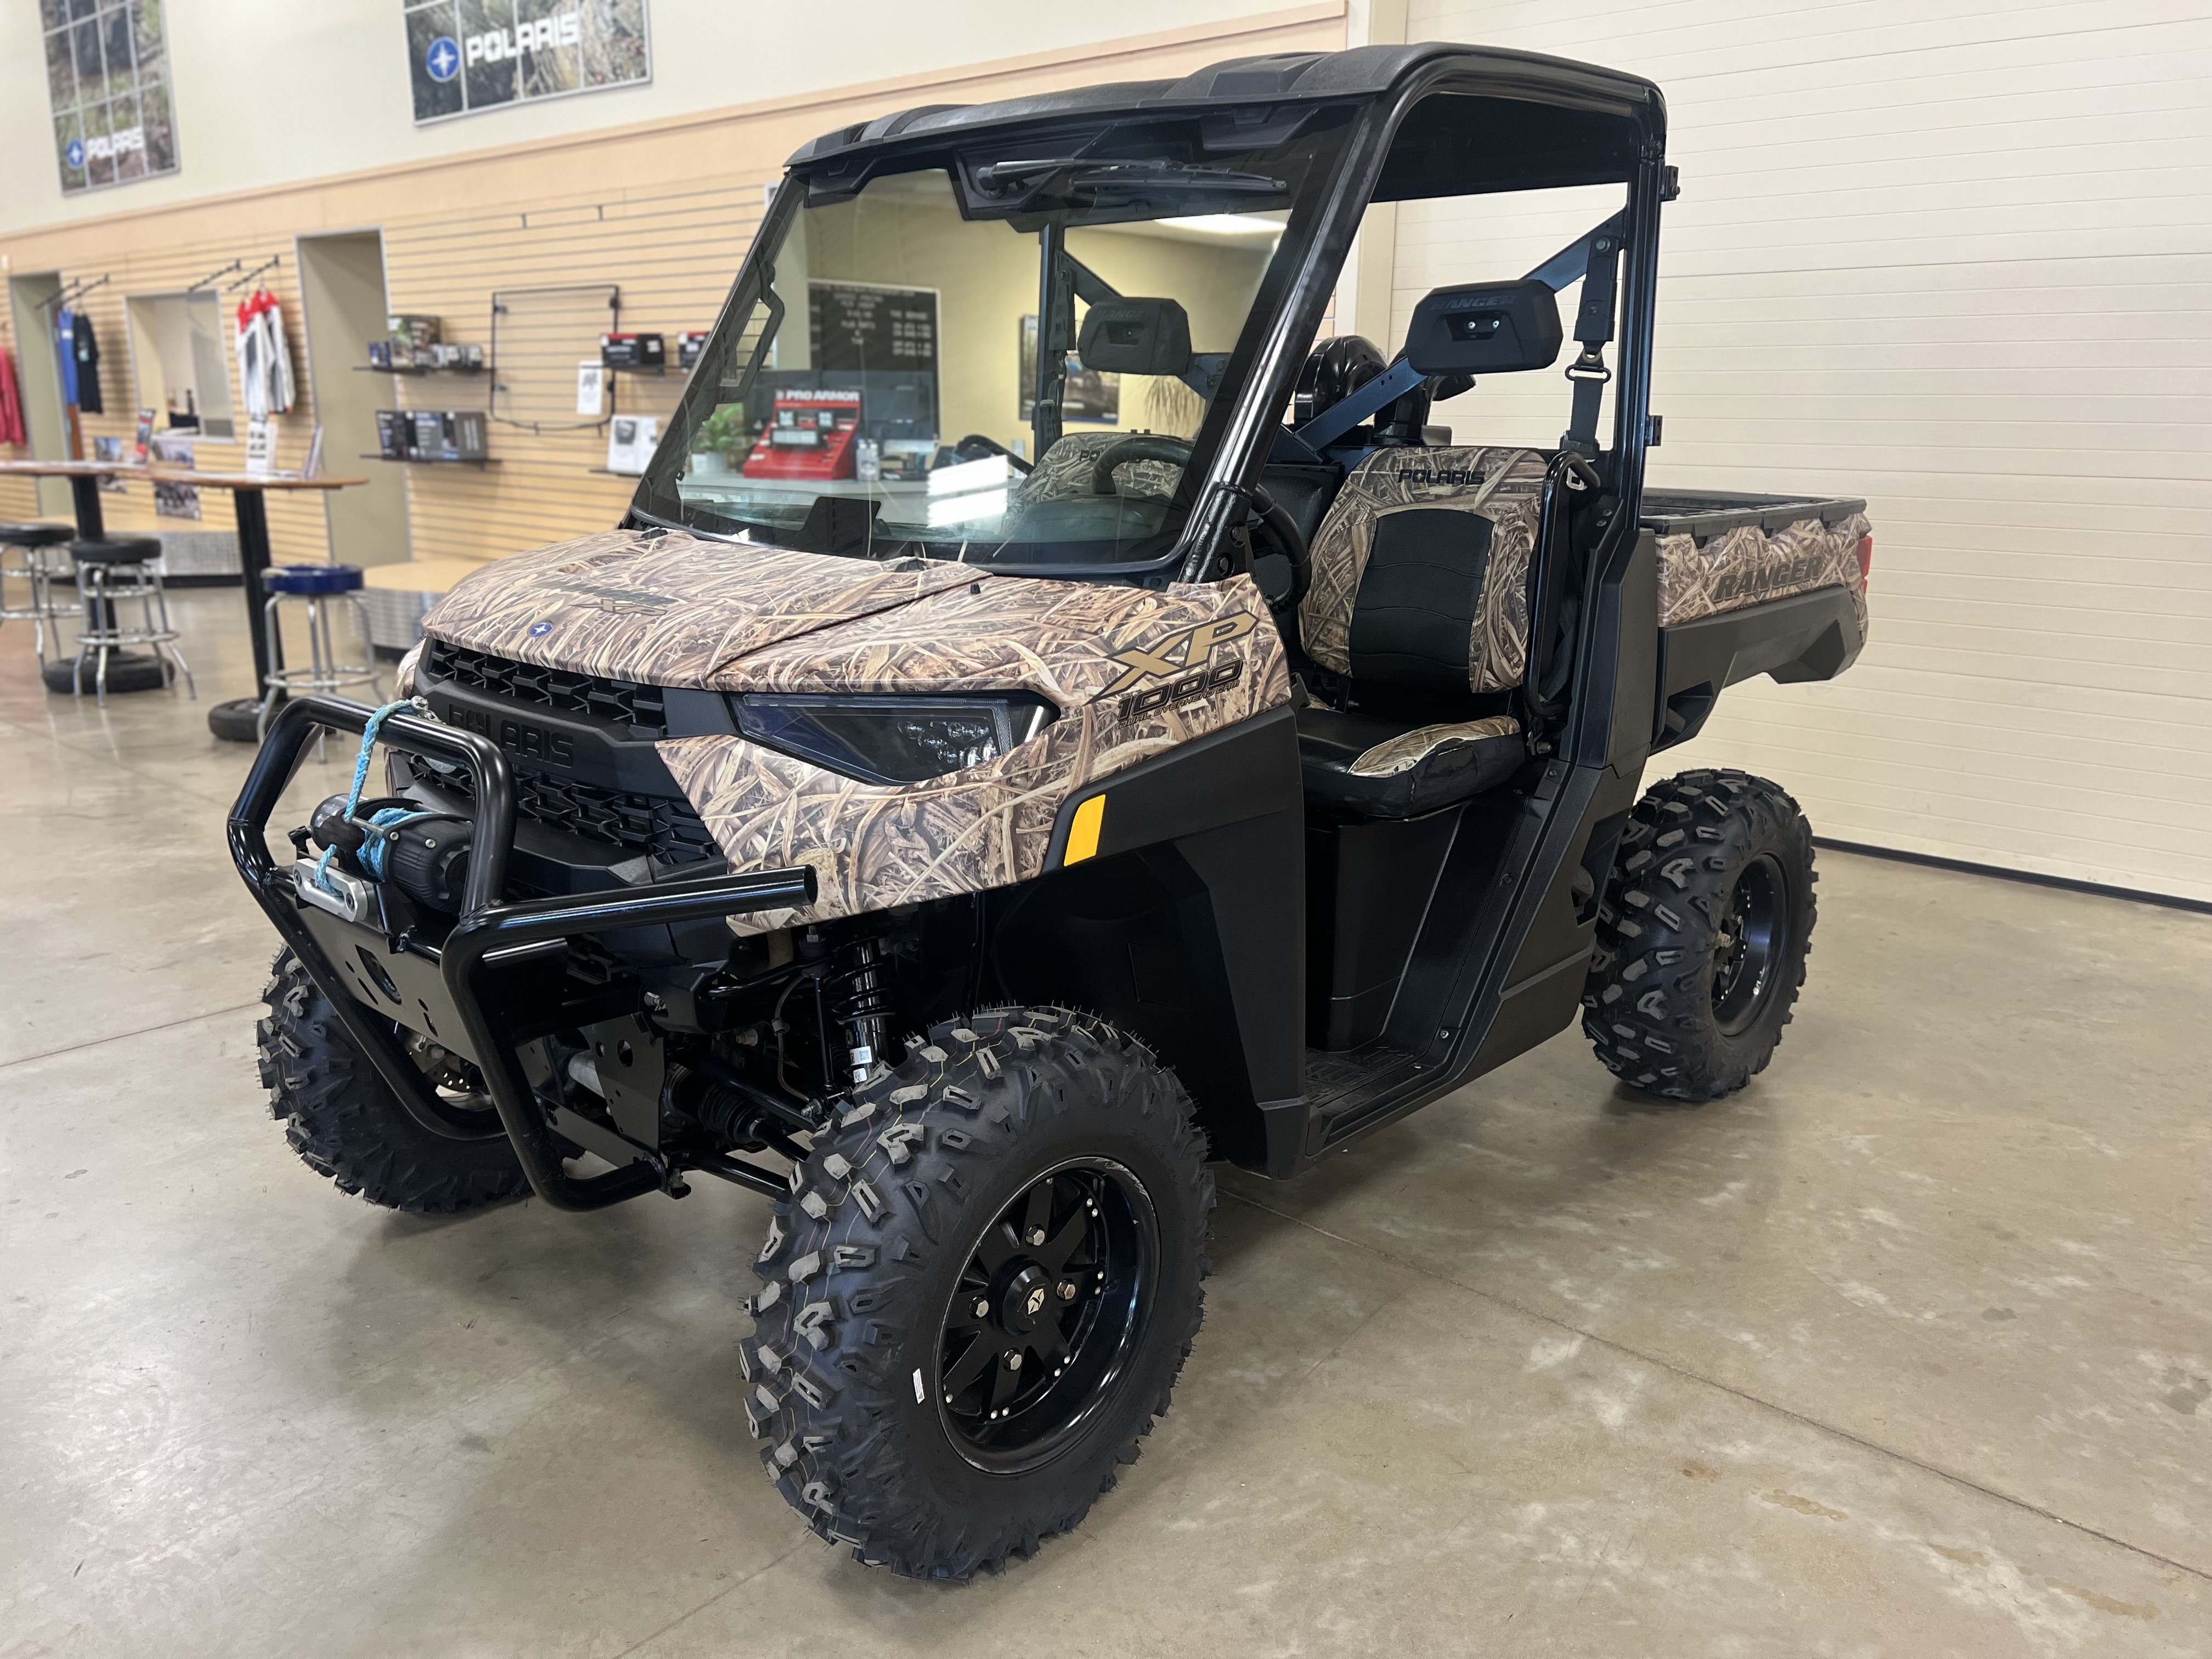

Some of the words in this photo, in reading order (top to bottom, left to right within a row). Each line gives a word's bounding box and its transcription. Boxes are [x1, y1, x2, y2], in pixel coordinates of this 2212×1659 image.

[466, 11, 580, 68] POLARIS
[87, 127, 144, 161] POLARIS
[786, 390, 812, 401] PRO
[814, 390, 860, 402] ARMOR
[1398, 469, 1486, 485] POLARIS
[1713, 555, 1822, 602] RANGER
[1083, 609, 1260, 706] XP
[1117, 658, 1244, 721] 1000
[1118, 713, 1151, 730] DUAL
[1153, 689, 1215, 718] OVERHEAD
[1215, 680, 1240, 695] CAM
